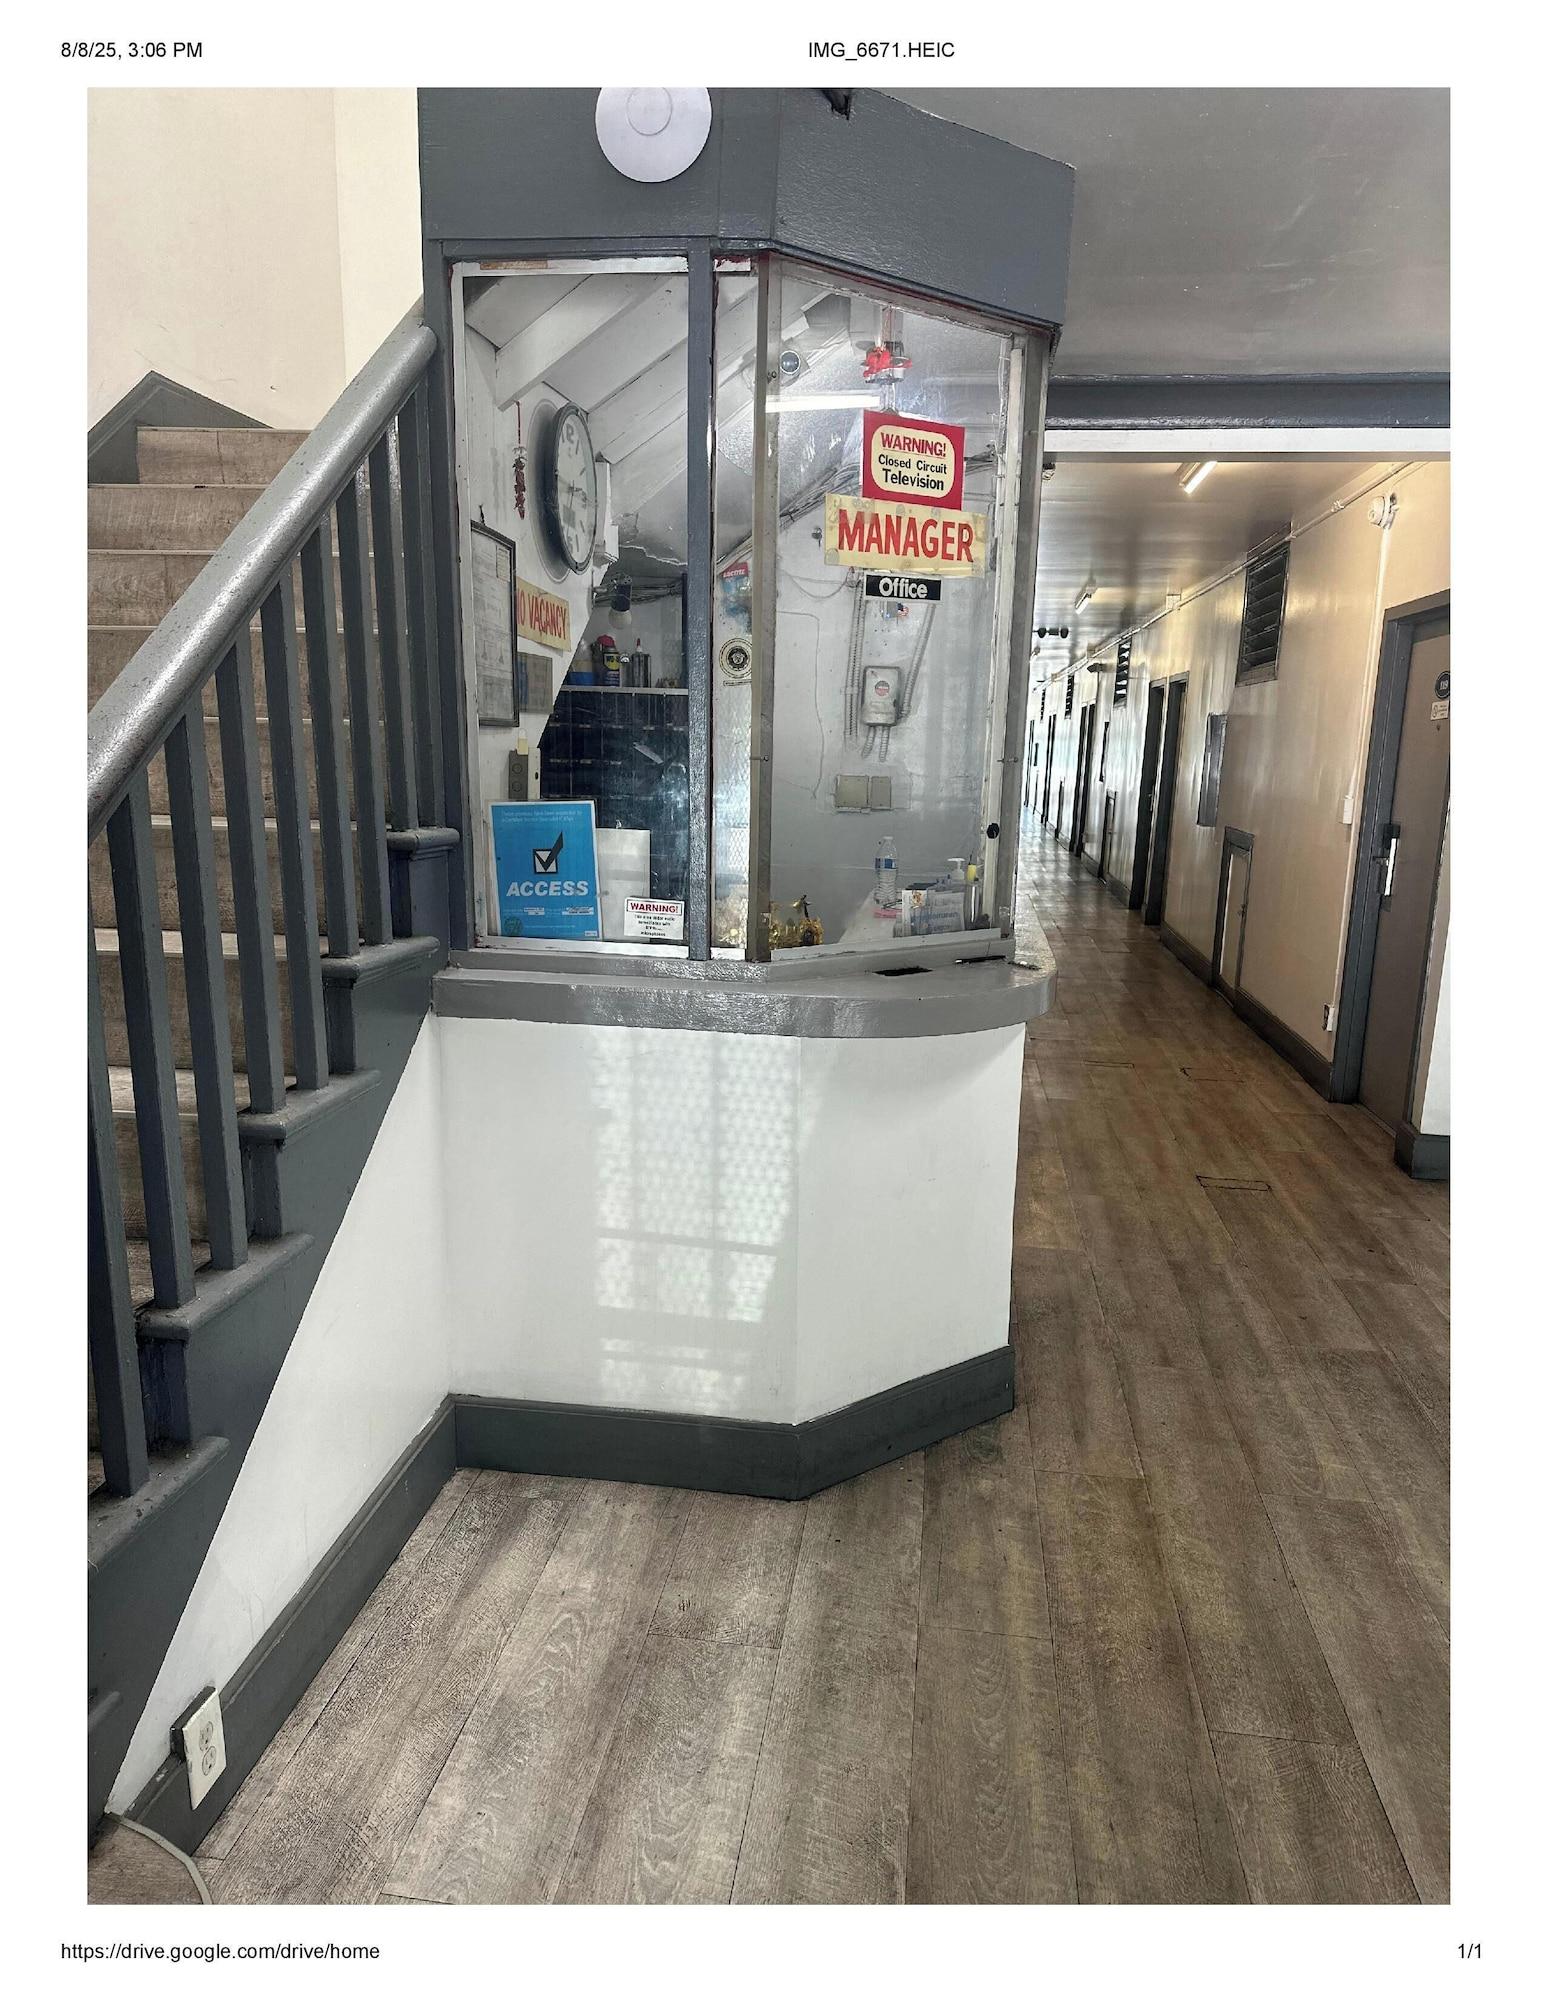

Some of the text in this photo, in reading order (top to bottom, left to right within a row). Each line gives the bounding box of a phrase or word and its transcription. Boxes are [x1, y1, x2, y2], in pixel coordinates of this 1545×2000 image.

[880, 432, 947, 457] WARNING!
[878, 454, 947, 475] Closed Circuit
[882, 468, 944, 491] Television
[838, 509, 974, 563] MANAGER
[878, 576, 928, 599] Office
[528, 592, 567, 640] VACANCY
[506, 880, 589, 897] ACCESS
[630, 902, 679, 913] WARNING!
